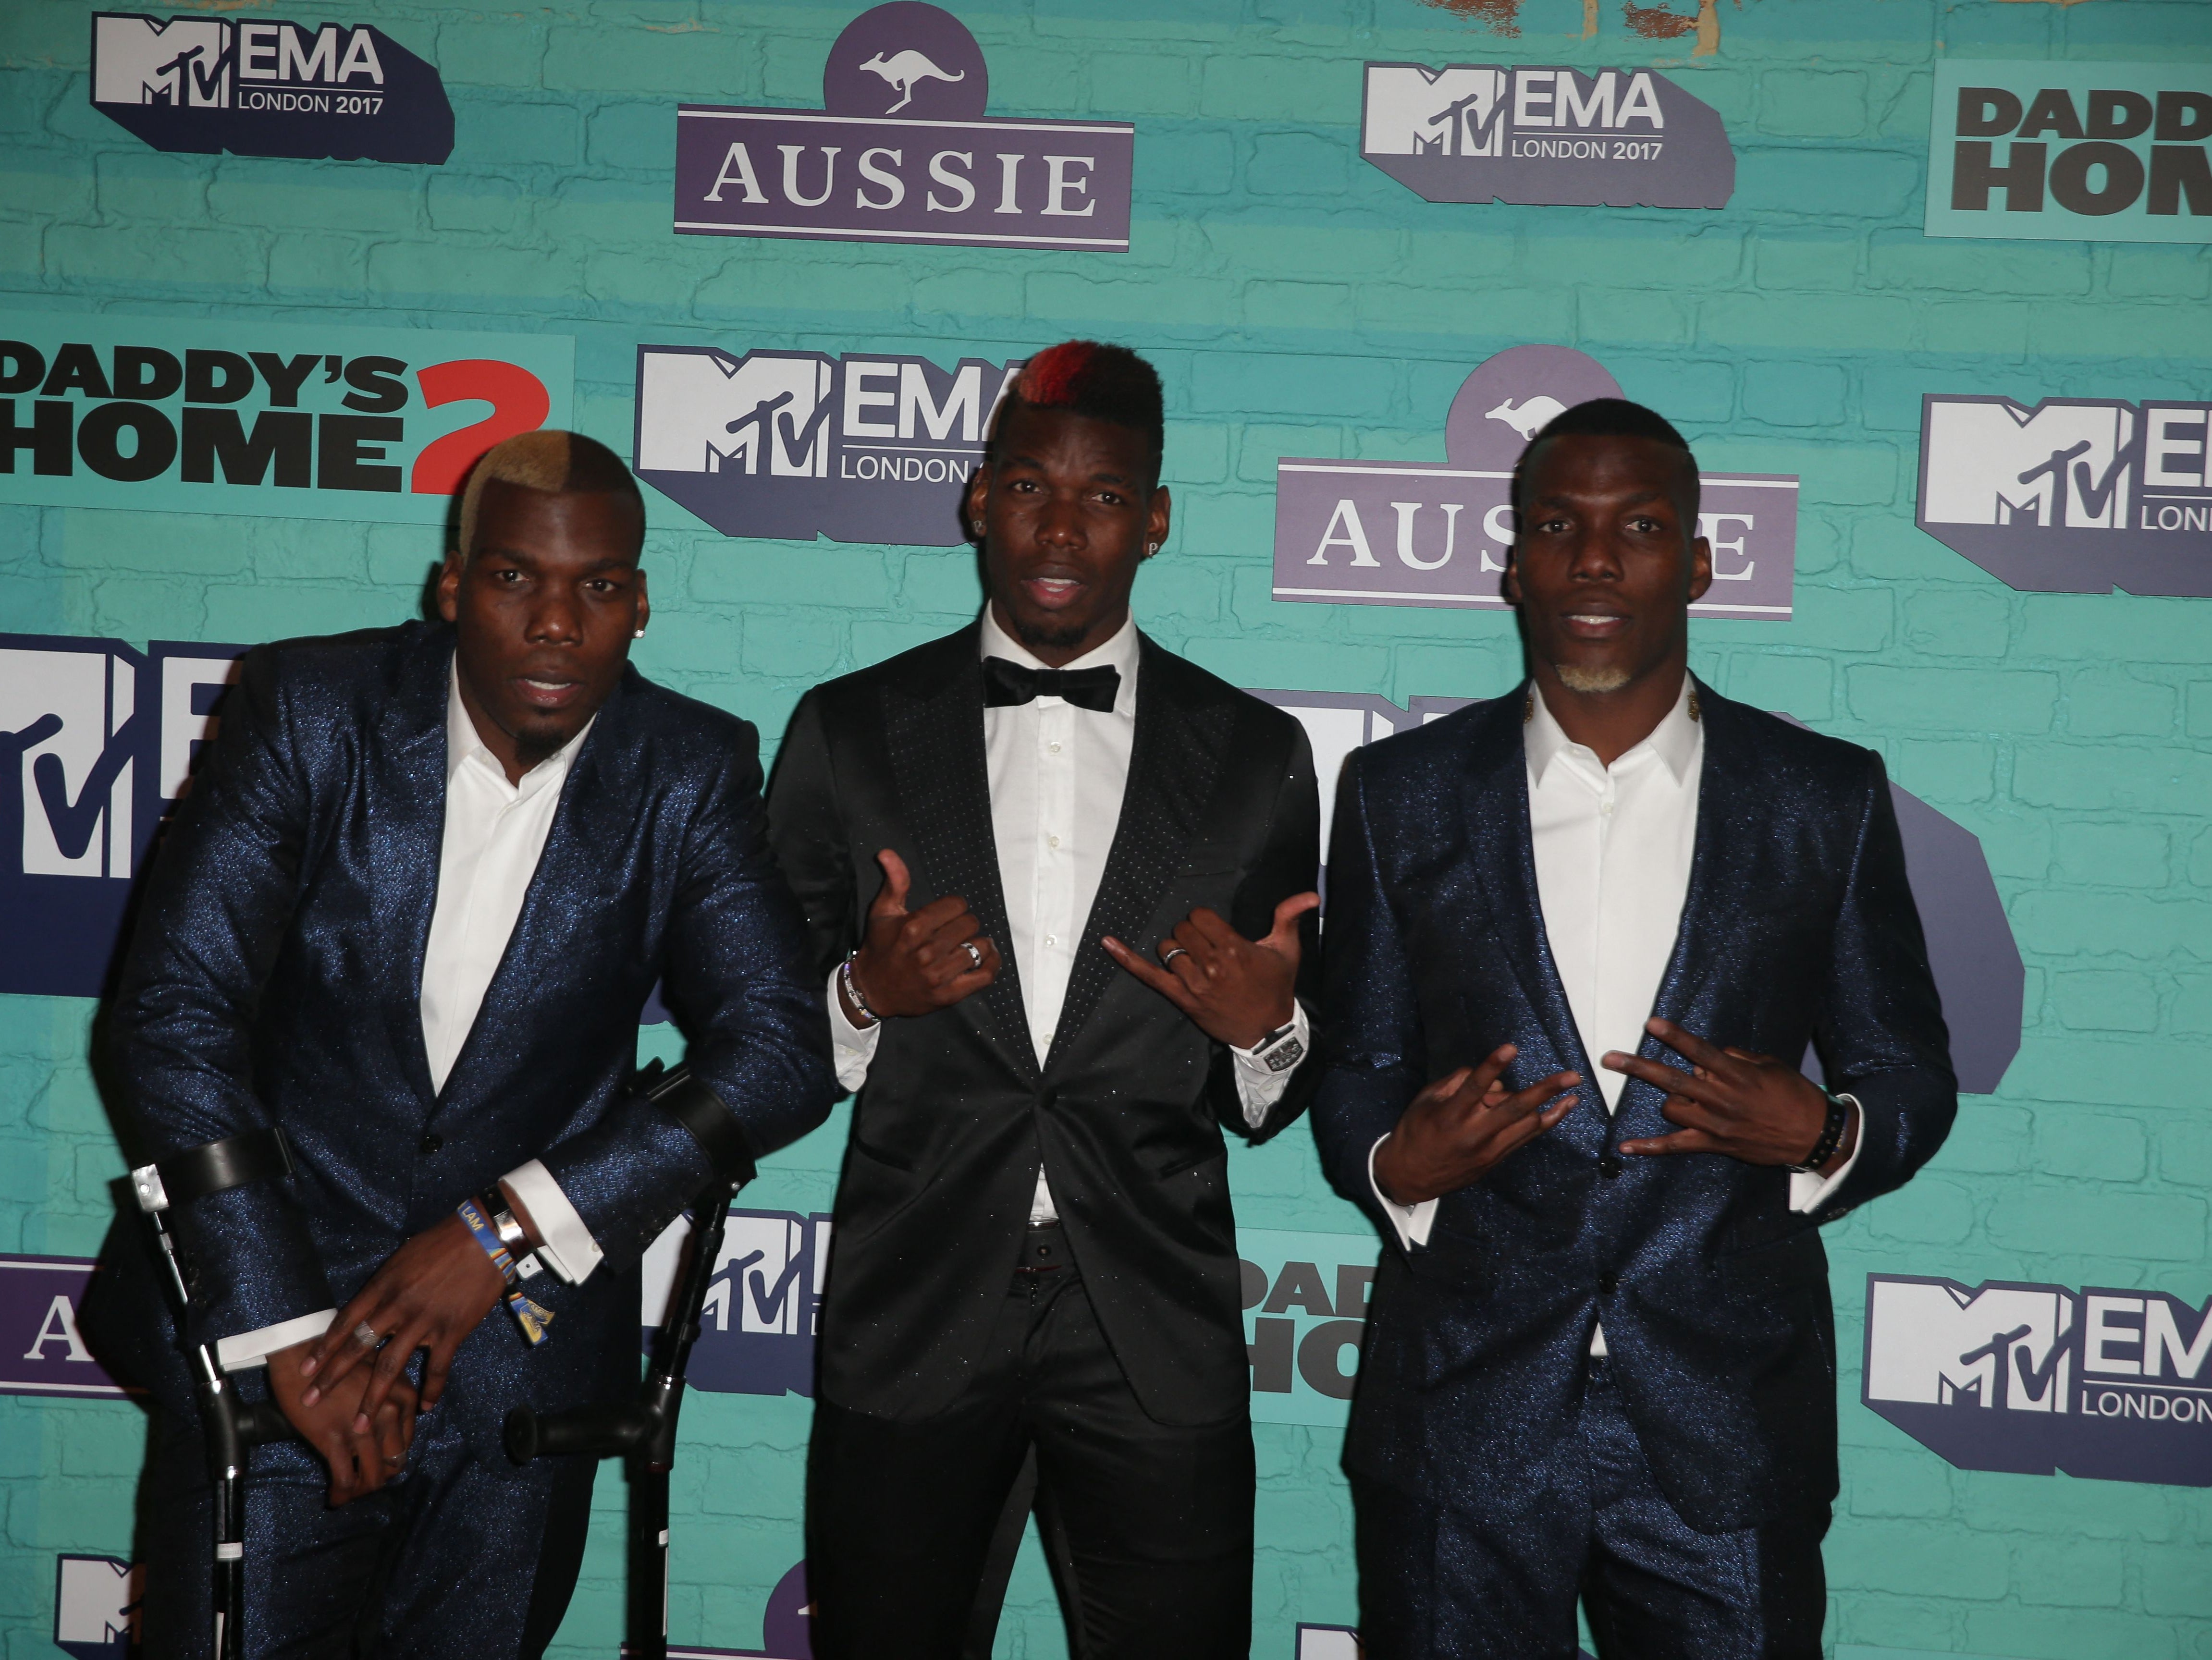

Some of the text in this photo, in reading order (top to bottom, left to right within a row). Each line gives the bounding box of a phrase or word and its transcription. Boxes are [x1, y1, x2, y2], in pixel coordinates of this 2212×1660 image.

[96, 17, 383, 108] MTV EMA
[239, 92, 383, 115] LONDON 2017
[1364, 67, 1664, 157] MTV EMA
[1512, 140, 1663, 160] LONDON 2017
[703, 142, 1095, 217] AUSSIE
[0, 398, 404, 493] HOME
[639, 352, 832, 477] MTV
[841, 455, 969, 483] LONDON
[1925, 403, 2132, 529] MTV
[1306, 498, 1754, 581] AUSE
[1868, 1281, 2072, 1413] MTV
